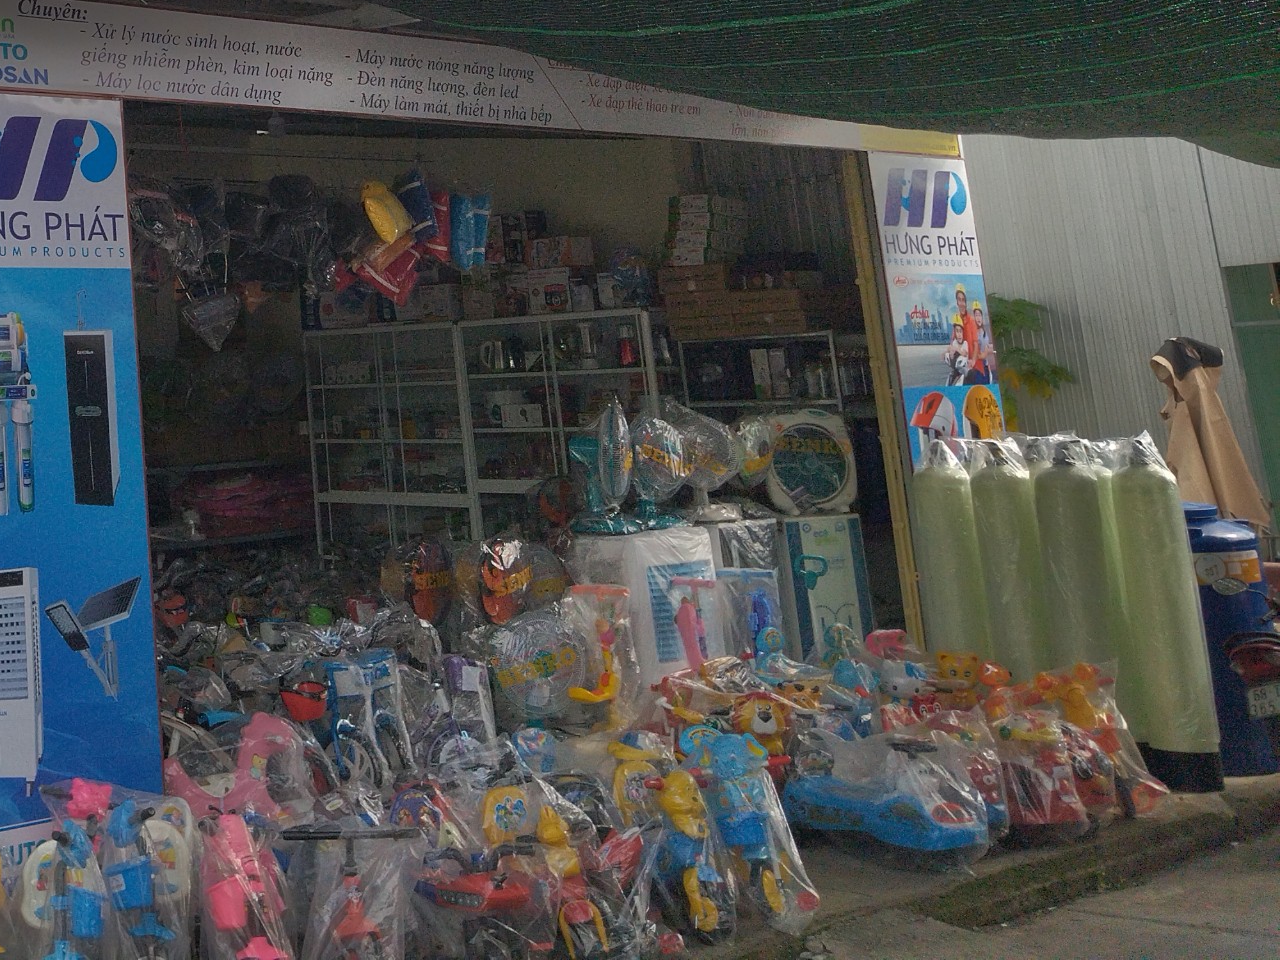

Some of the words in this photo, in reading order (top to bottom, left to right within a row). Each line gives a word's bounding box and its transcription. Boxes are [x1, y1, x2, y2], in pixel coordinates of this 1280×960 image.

[91, 21, 117, 40] Xử
[121, 24, 136, 46] lý
[141, 30, 180, 46] nước
[185, 33, 218, 51] sinh
[223, 35, 259, 56] hoạt,
[265, 42, 302, 58] nước
[80, 42, 128, 68] giếng
[132, 48, 181, 69] nhiễm
[185, 55, 228, 76] phèn,
[233, 59, 260, 77] kim
[265, 64, 294, 82] loại
[298, 67, 334, 87] nặng
[356, 49, 385, 67] Máy
[389, 53, 423, 70] nước
[427, 58, 460, 76] nóng
[463, 61, 495, 79] năng
[499, 63, 535, 83] lượng
[586, 73, 600, 88] Xe
[96, 71, 131, 92] Máy
[137, 76, 162, 94] lọc
[166, 79, 206, 96] nước
[211, 81, 240, 98] dân
[244, 87, 283, 106] dụng
[357, 70, 386, 88] Đèn
[390, 76, 424, 94] năng
[428, 77, 469, 98] lượng,
[473, 84, 497, 99] đèn
[500, 85, 519, 100] led
[360, 92, 391, 113] Máy
[394, 96, 420, 113] làm
[423, 99, 451, 116] mát,
[456, 98, 483, 116] thiết
[488, 104, 500, 122] bị
[504, 105, 527, 121] nhà
[531, 103, 553, 126] bếp
[588, 93, 602, 109] Xe
[605, 96, 626, 114] đạp
[46, 206, 125, 242] PHÁT
[30, 246, 126, 259] PRODUCTS
[884, 232, 932, 255] HƯNG
[937, 231, 976, 257] PHÁT
[887, 259, 930, 267] PREMIUM
[932, 259, 979, 268] PRODUCTS
